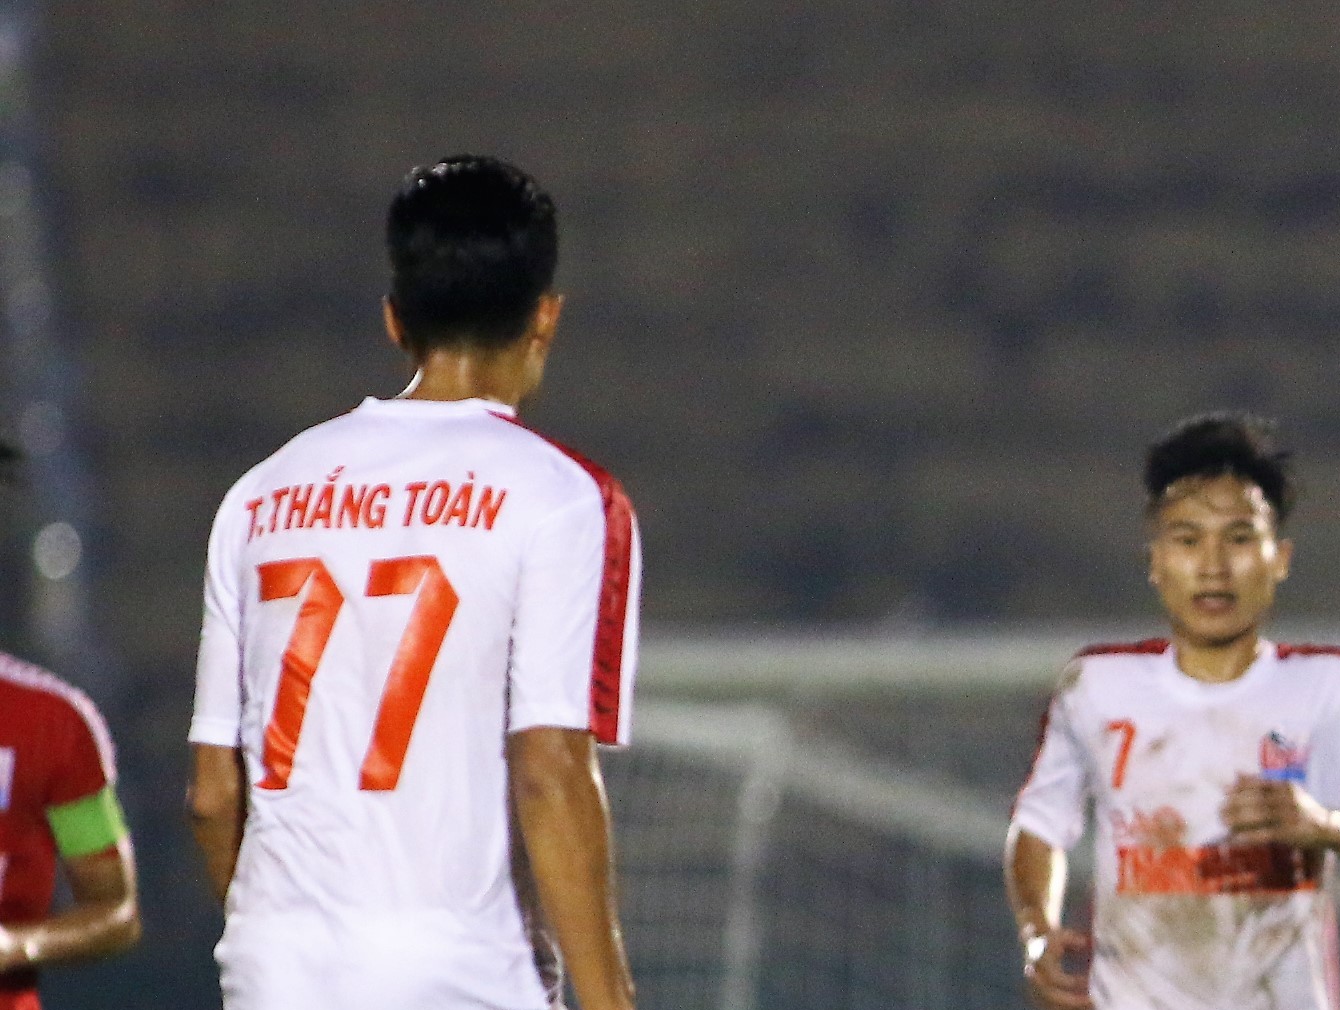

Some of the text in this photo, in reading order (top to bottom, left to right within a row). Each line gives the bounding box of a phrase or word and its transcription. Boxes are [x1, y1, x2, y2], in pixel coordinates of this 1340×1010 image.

[245, 466, 507, 543] T.THẮNG TOÀN
[255, 555, 460, 791] 77
[1106, 717, 1137, 790] 7
